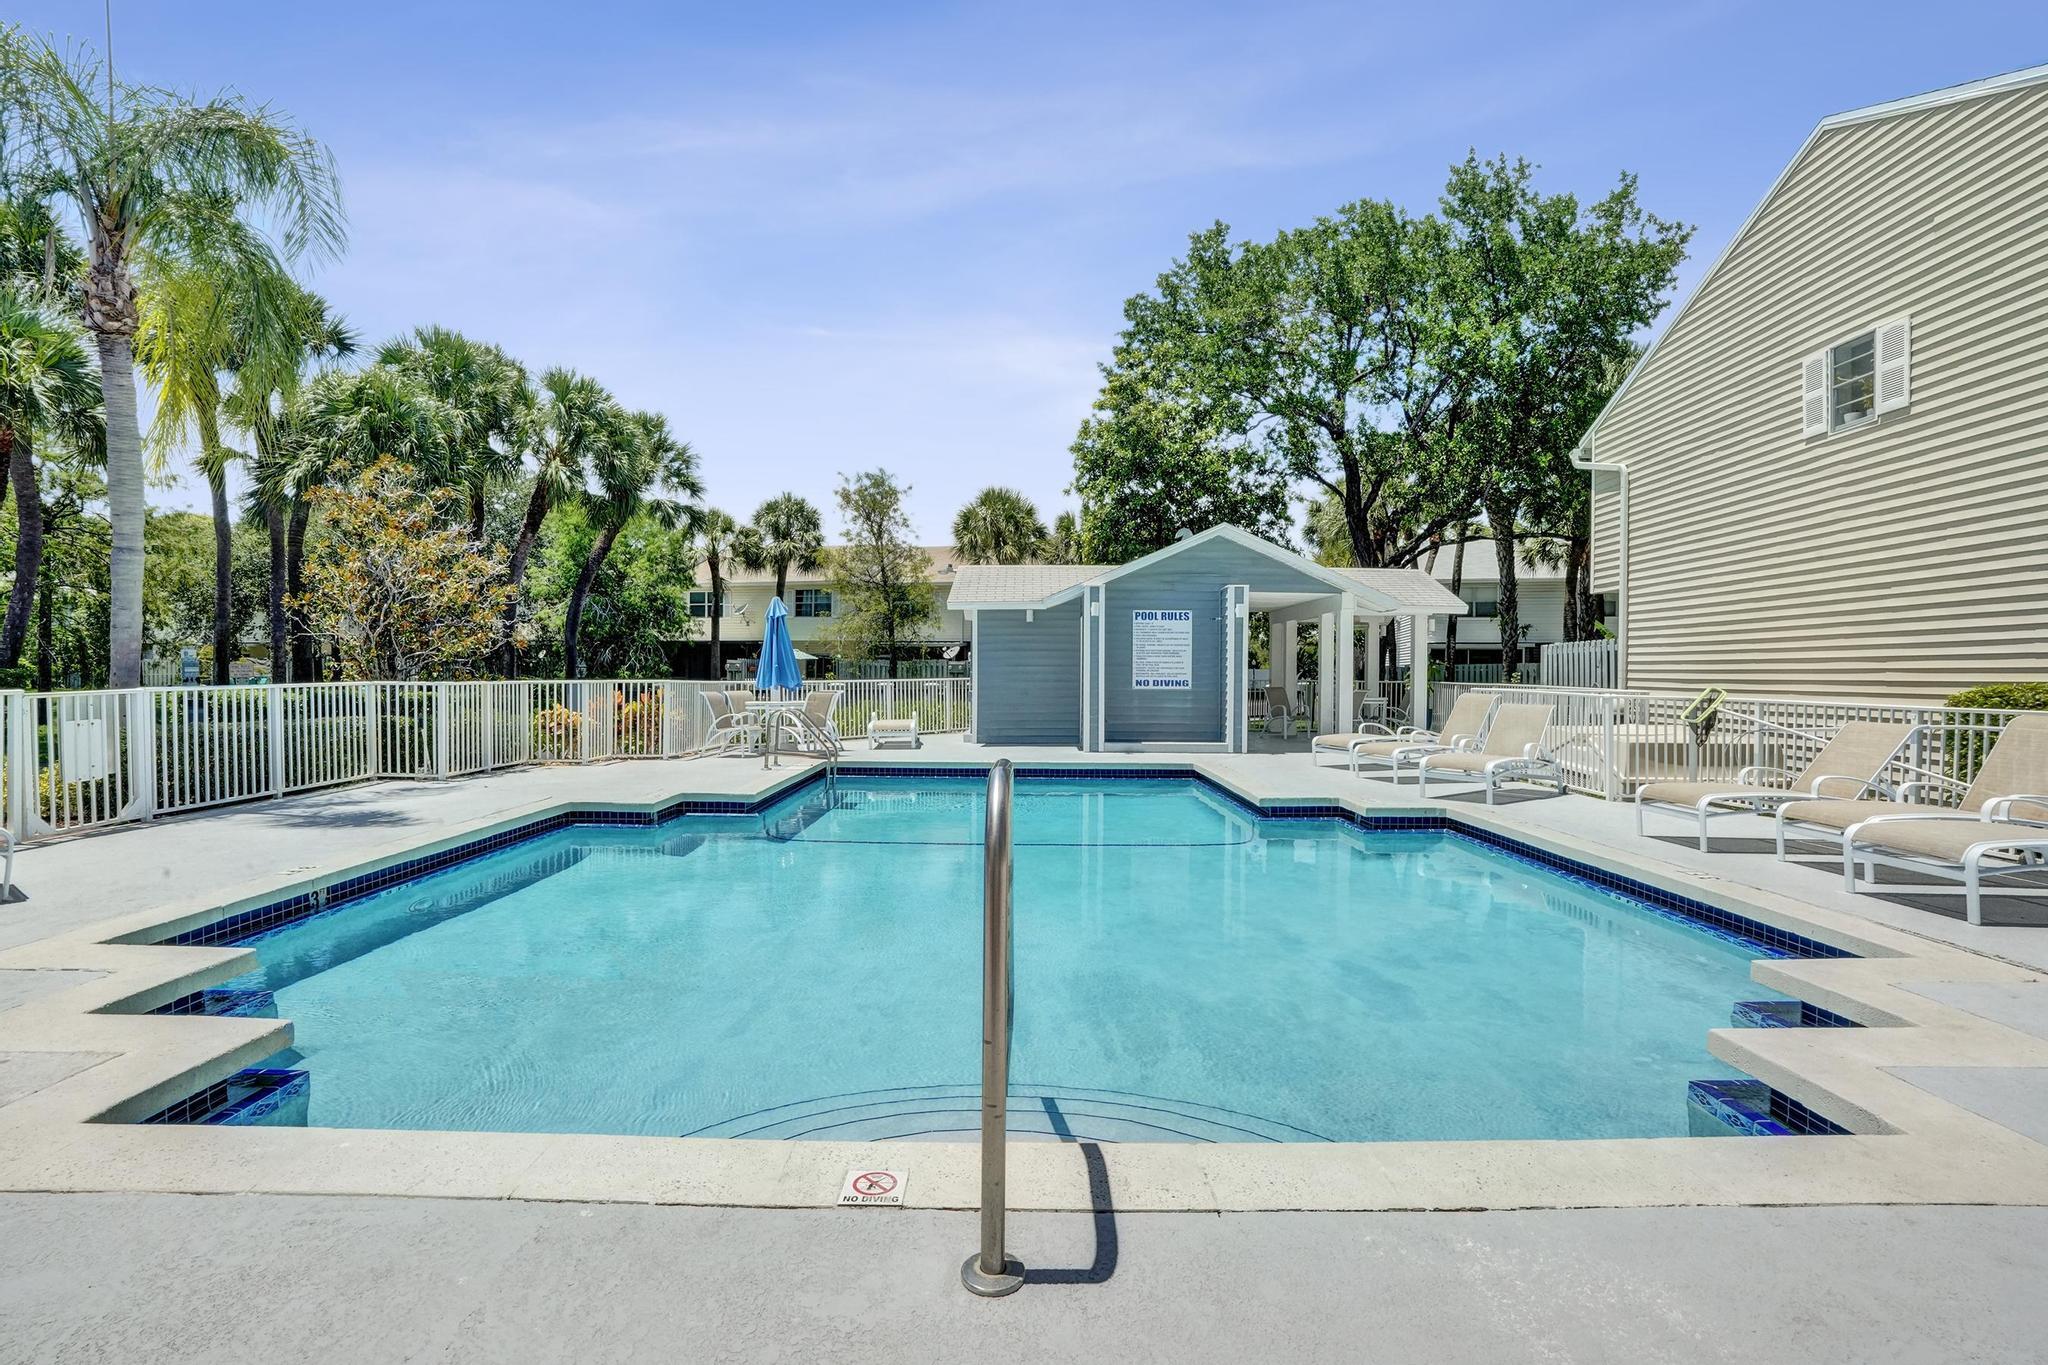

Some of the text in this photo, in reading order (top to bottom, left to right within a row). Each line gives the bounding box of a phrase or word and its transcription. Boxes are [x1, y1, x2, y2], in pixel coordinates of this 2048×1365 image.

[1135, 611, 1190, 621] POOL RULES
[1135, 679, 1189, 687] NO DIVING
[310, 890, 320, 907] 3
